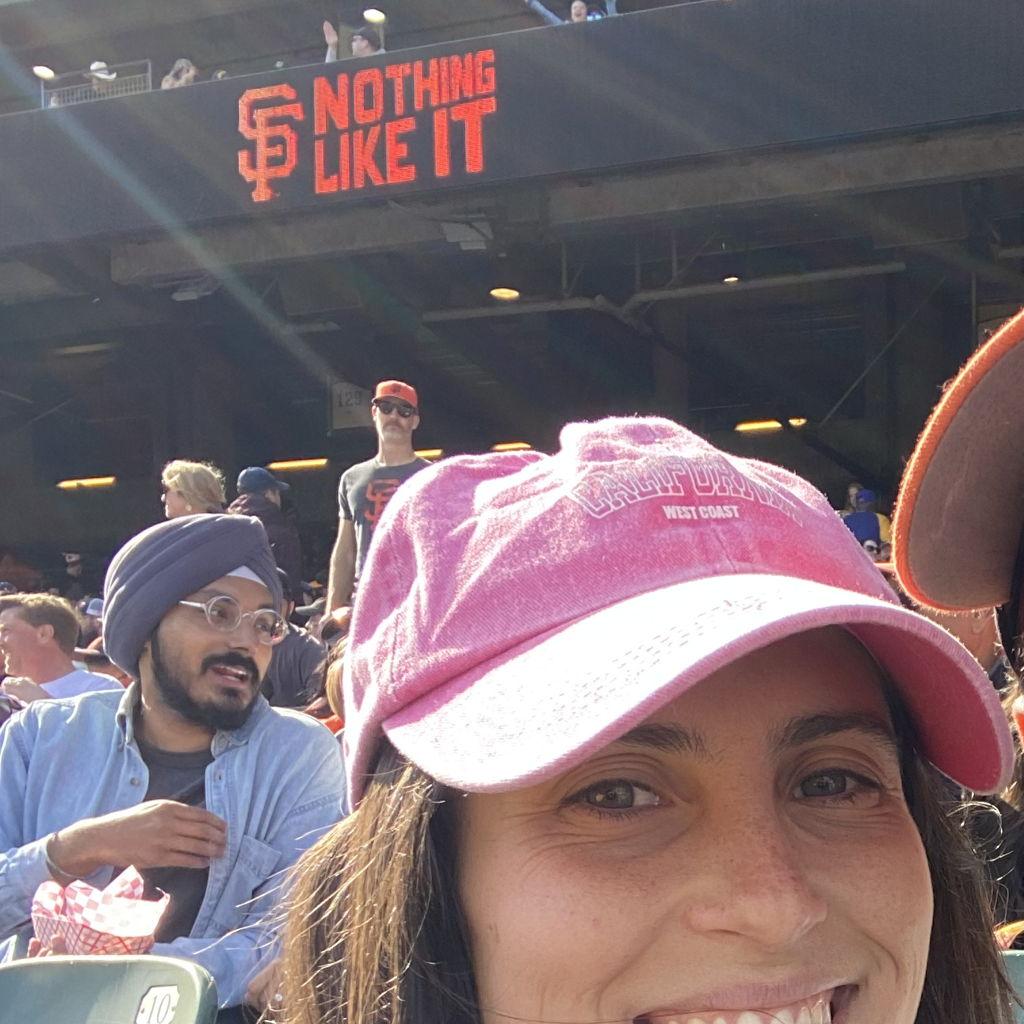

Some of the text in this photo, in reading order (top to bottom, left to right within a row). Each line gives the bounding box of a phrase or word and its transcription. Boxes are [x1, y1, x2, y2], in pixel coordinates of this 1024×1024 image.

[313, 49, 496, 135] NOTHING
[314, 97, 497, 194] LIKE IT
[662, 504, 740, 520] WEST COAST
[147, 993, 171, 1024] 10
